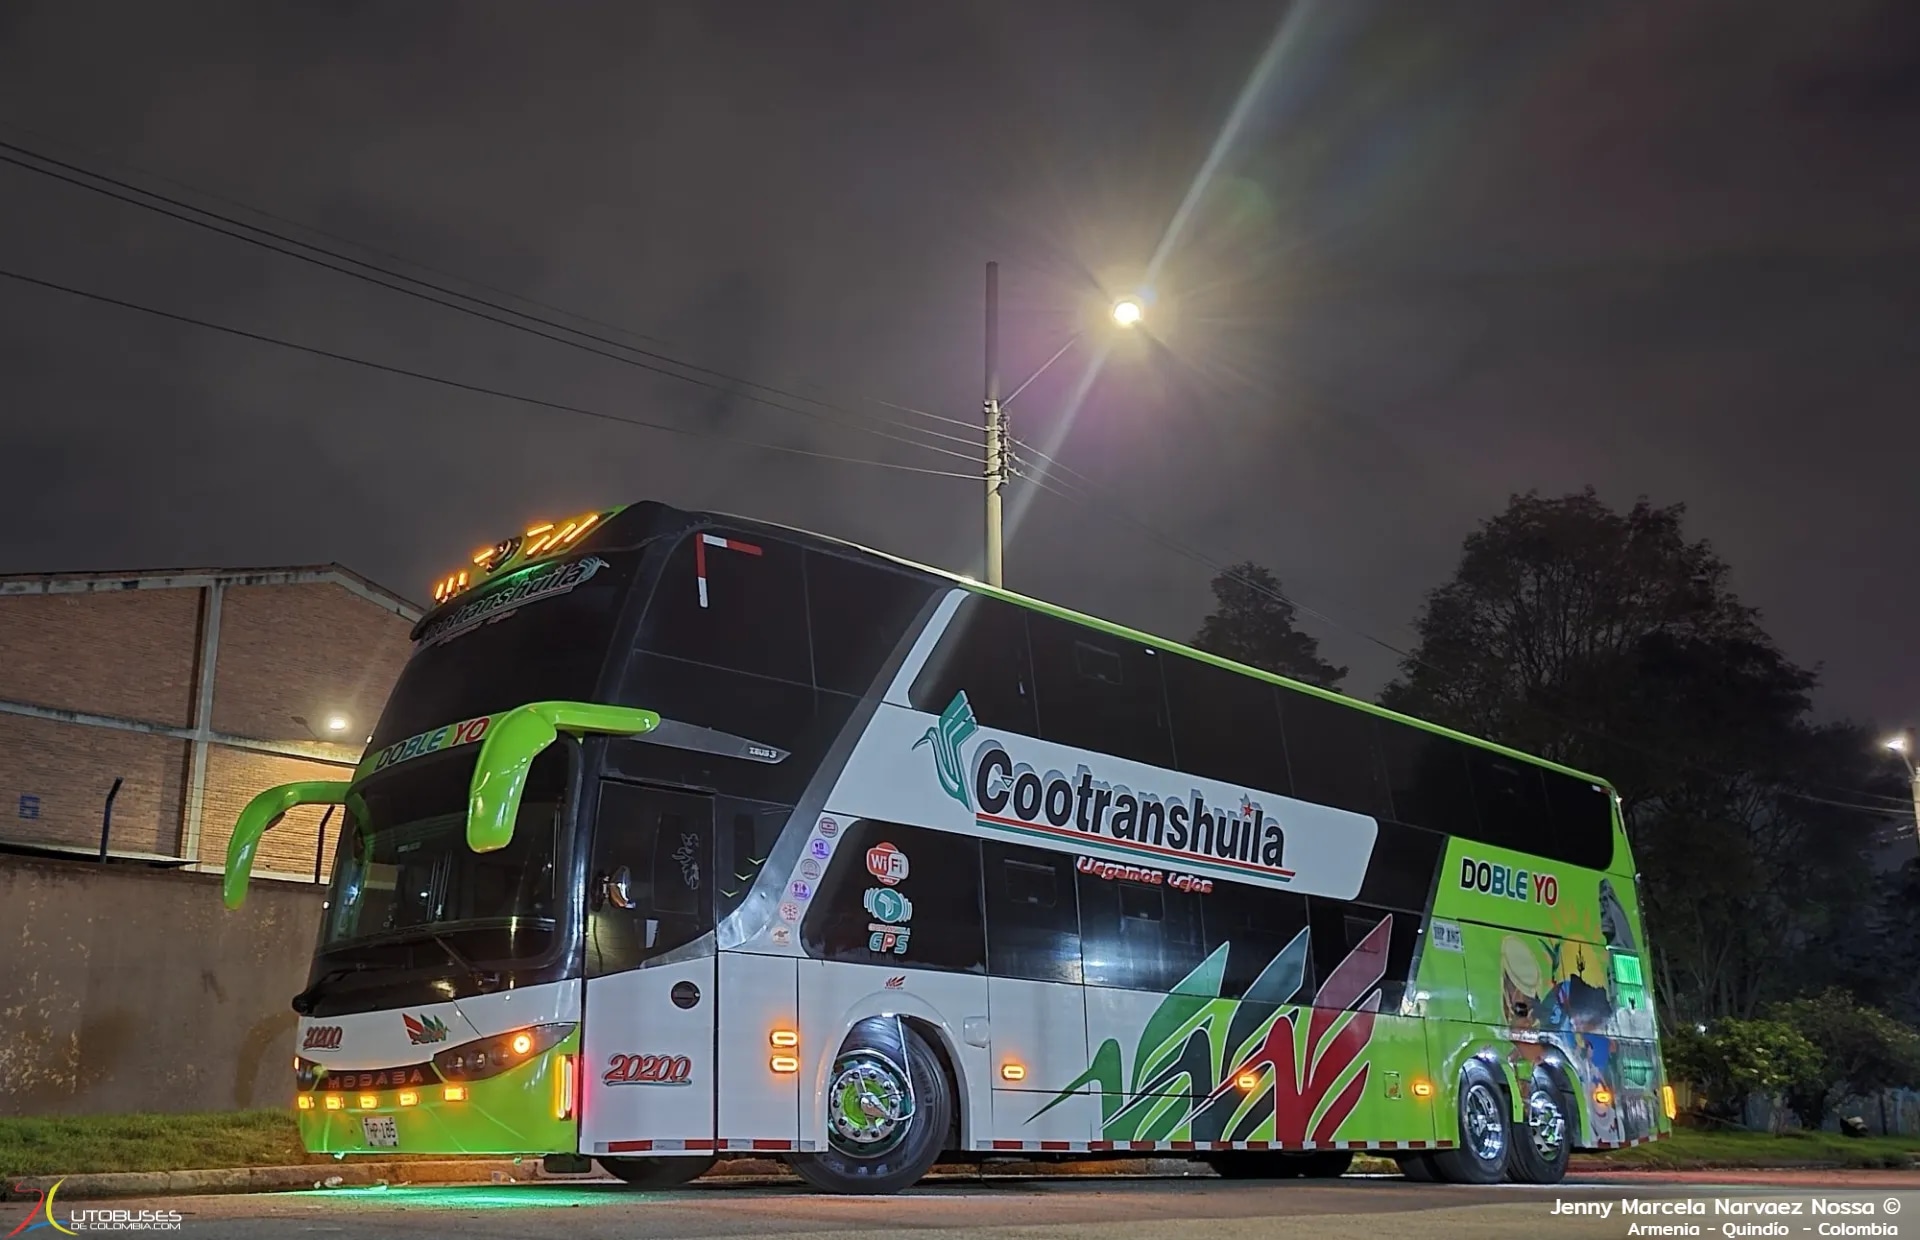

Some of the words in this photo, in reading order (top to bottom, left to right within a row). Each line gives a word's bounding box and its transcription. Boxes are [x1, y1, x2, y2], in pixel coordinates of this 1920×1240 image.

[374, 725, 450, 772] DOBLE
[450, 715, 491, 747] YO
[975, 742, 1285, 867] Cootranshuila
[1460, 856, 1528, 902] DOBLE
[1531, 871, 1559, 907] YO
[869, 932, 909, 954] GPS
[328, 1068, 424, 1089] MODASA
[602, 1053, 692, 1083] 20200
